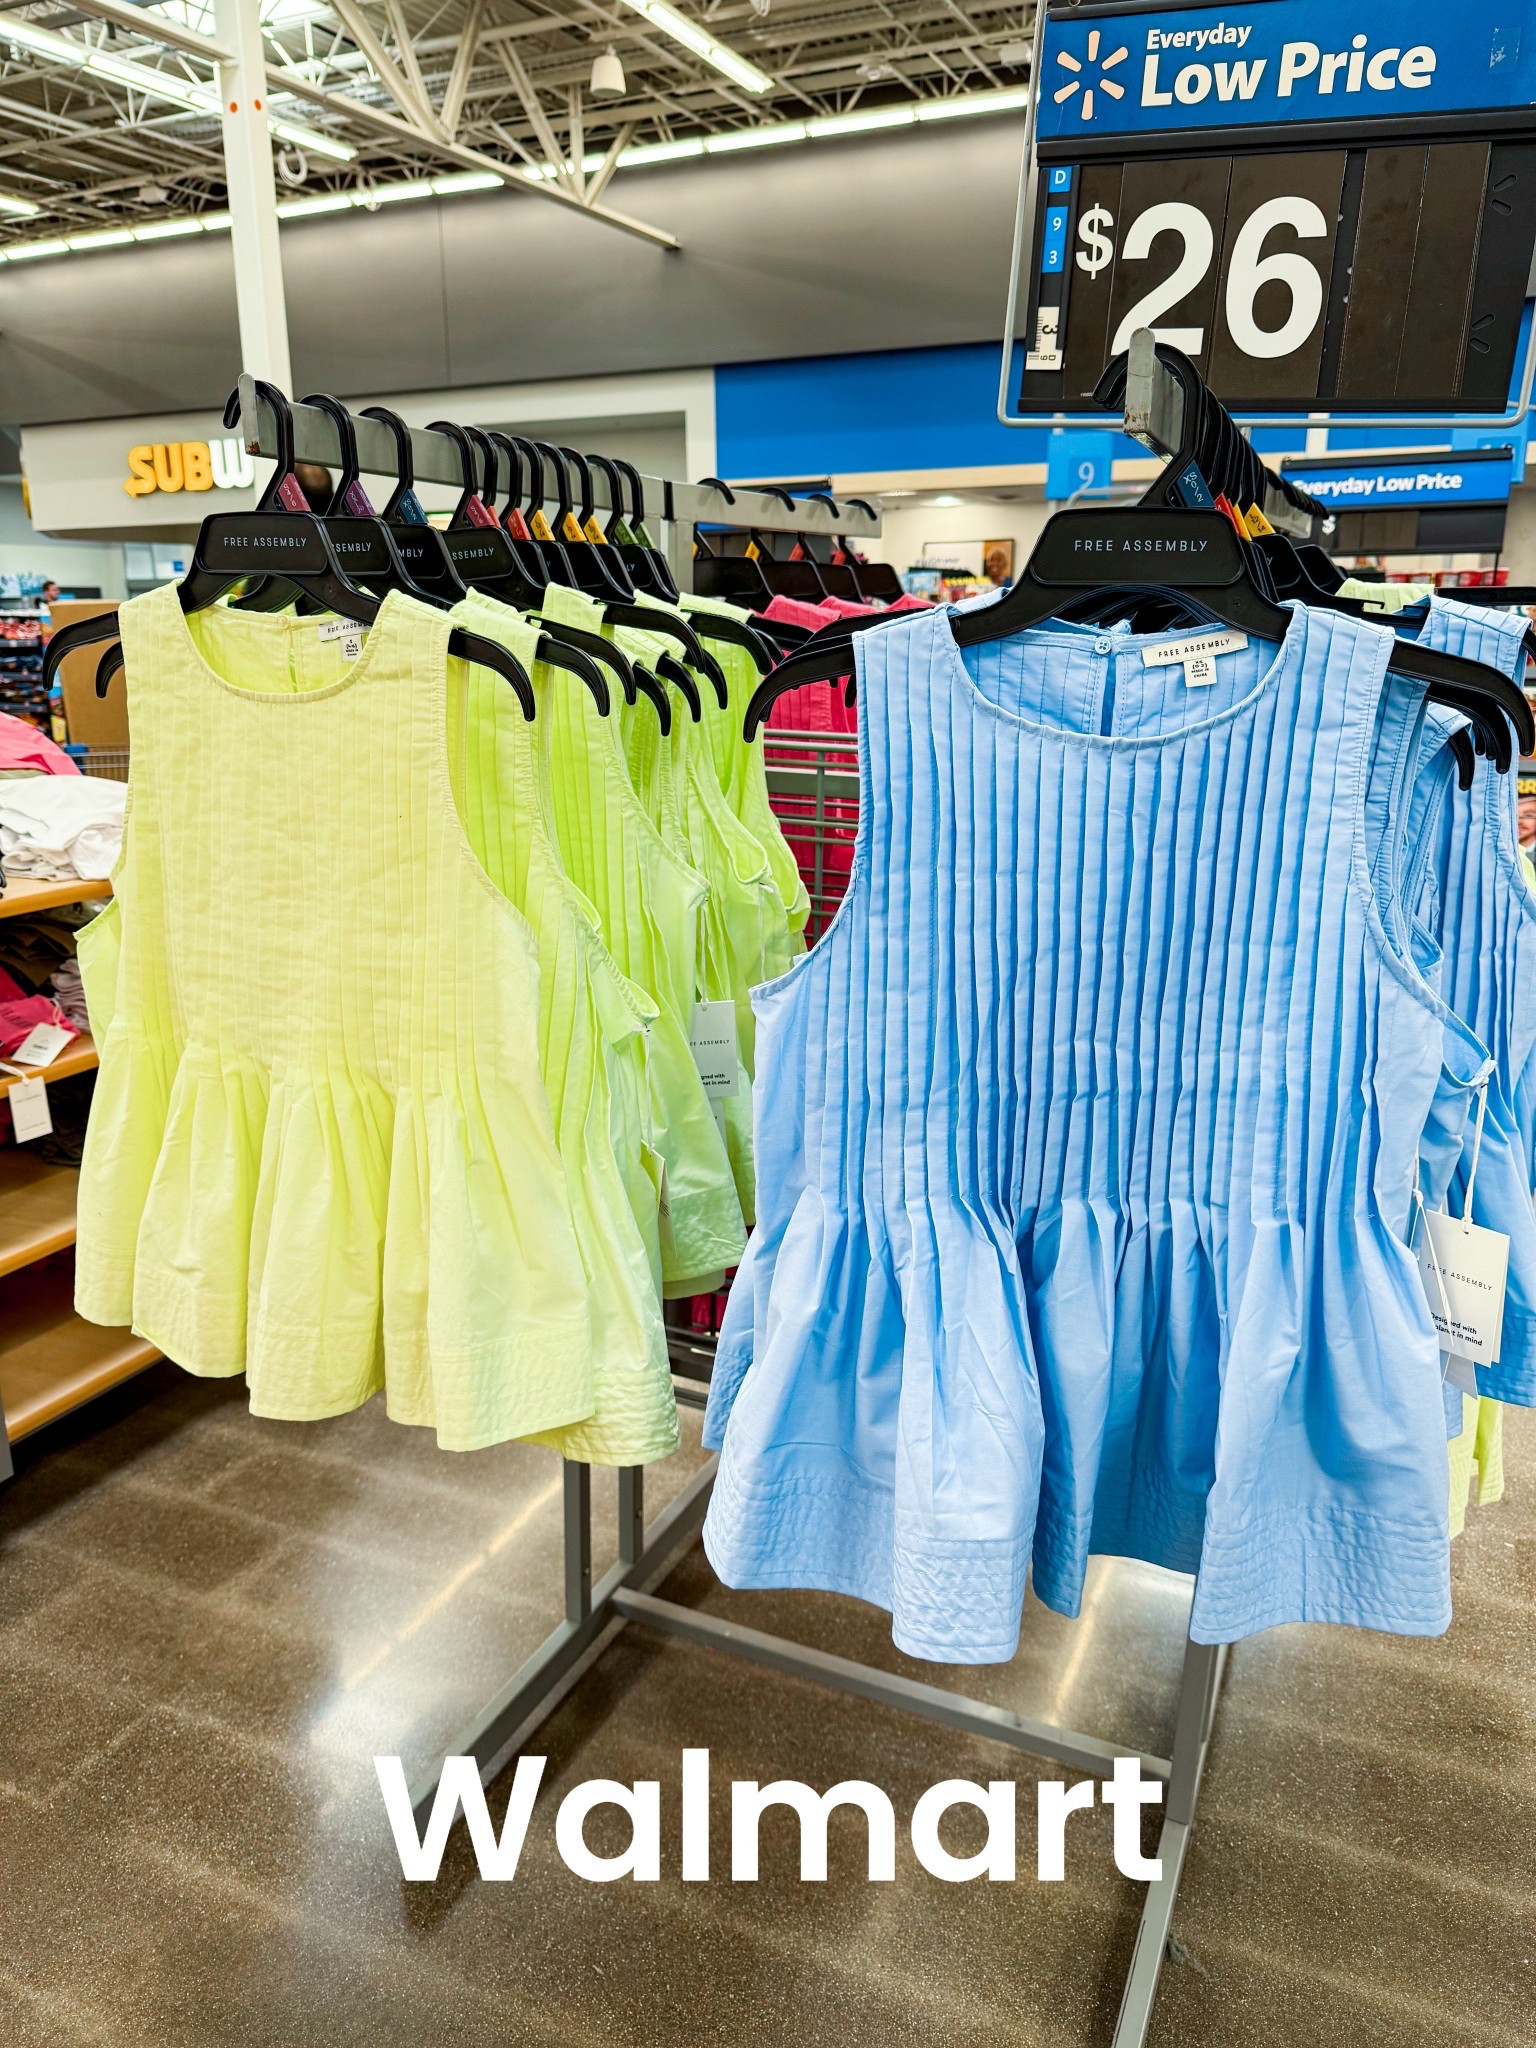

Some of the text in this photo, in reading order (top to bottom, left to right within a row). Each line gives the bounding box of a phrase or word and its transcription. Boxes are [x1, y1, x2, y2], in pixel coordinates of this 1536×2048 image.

[1147, 23, 1252, 51] Everyday
[1141, 34, 1437, 107] Low Price
[1049, 170, 1066, 264] D 9 3
[124, 438, 254, 497] SUBW
[1079, 461, 1094, 491] 9
[1377, 476, 1415, 492] Low
[1416, 472, 1462, 490] Price
[223, 537, 308, 548] FREE ASSEMBLY
[331, 543, 372, 552] SEMBLY
[1074, 540, 1208, 552] FREE ASSEMBLY
[1158, 639, 1230, 658] FREE ASSEMBLY
[1450, 1272, 1492, 1290] ASSEMBLY
[1462, 1326, 1477, 1334] with
[1465, 1336, 1483, 1346] mind
